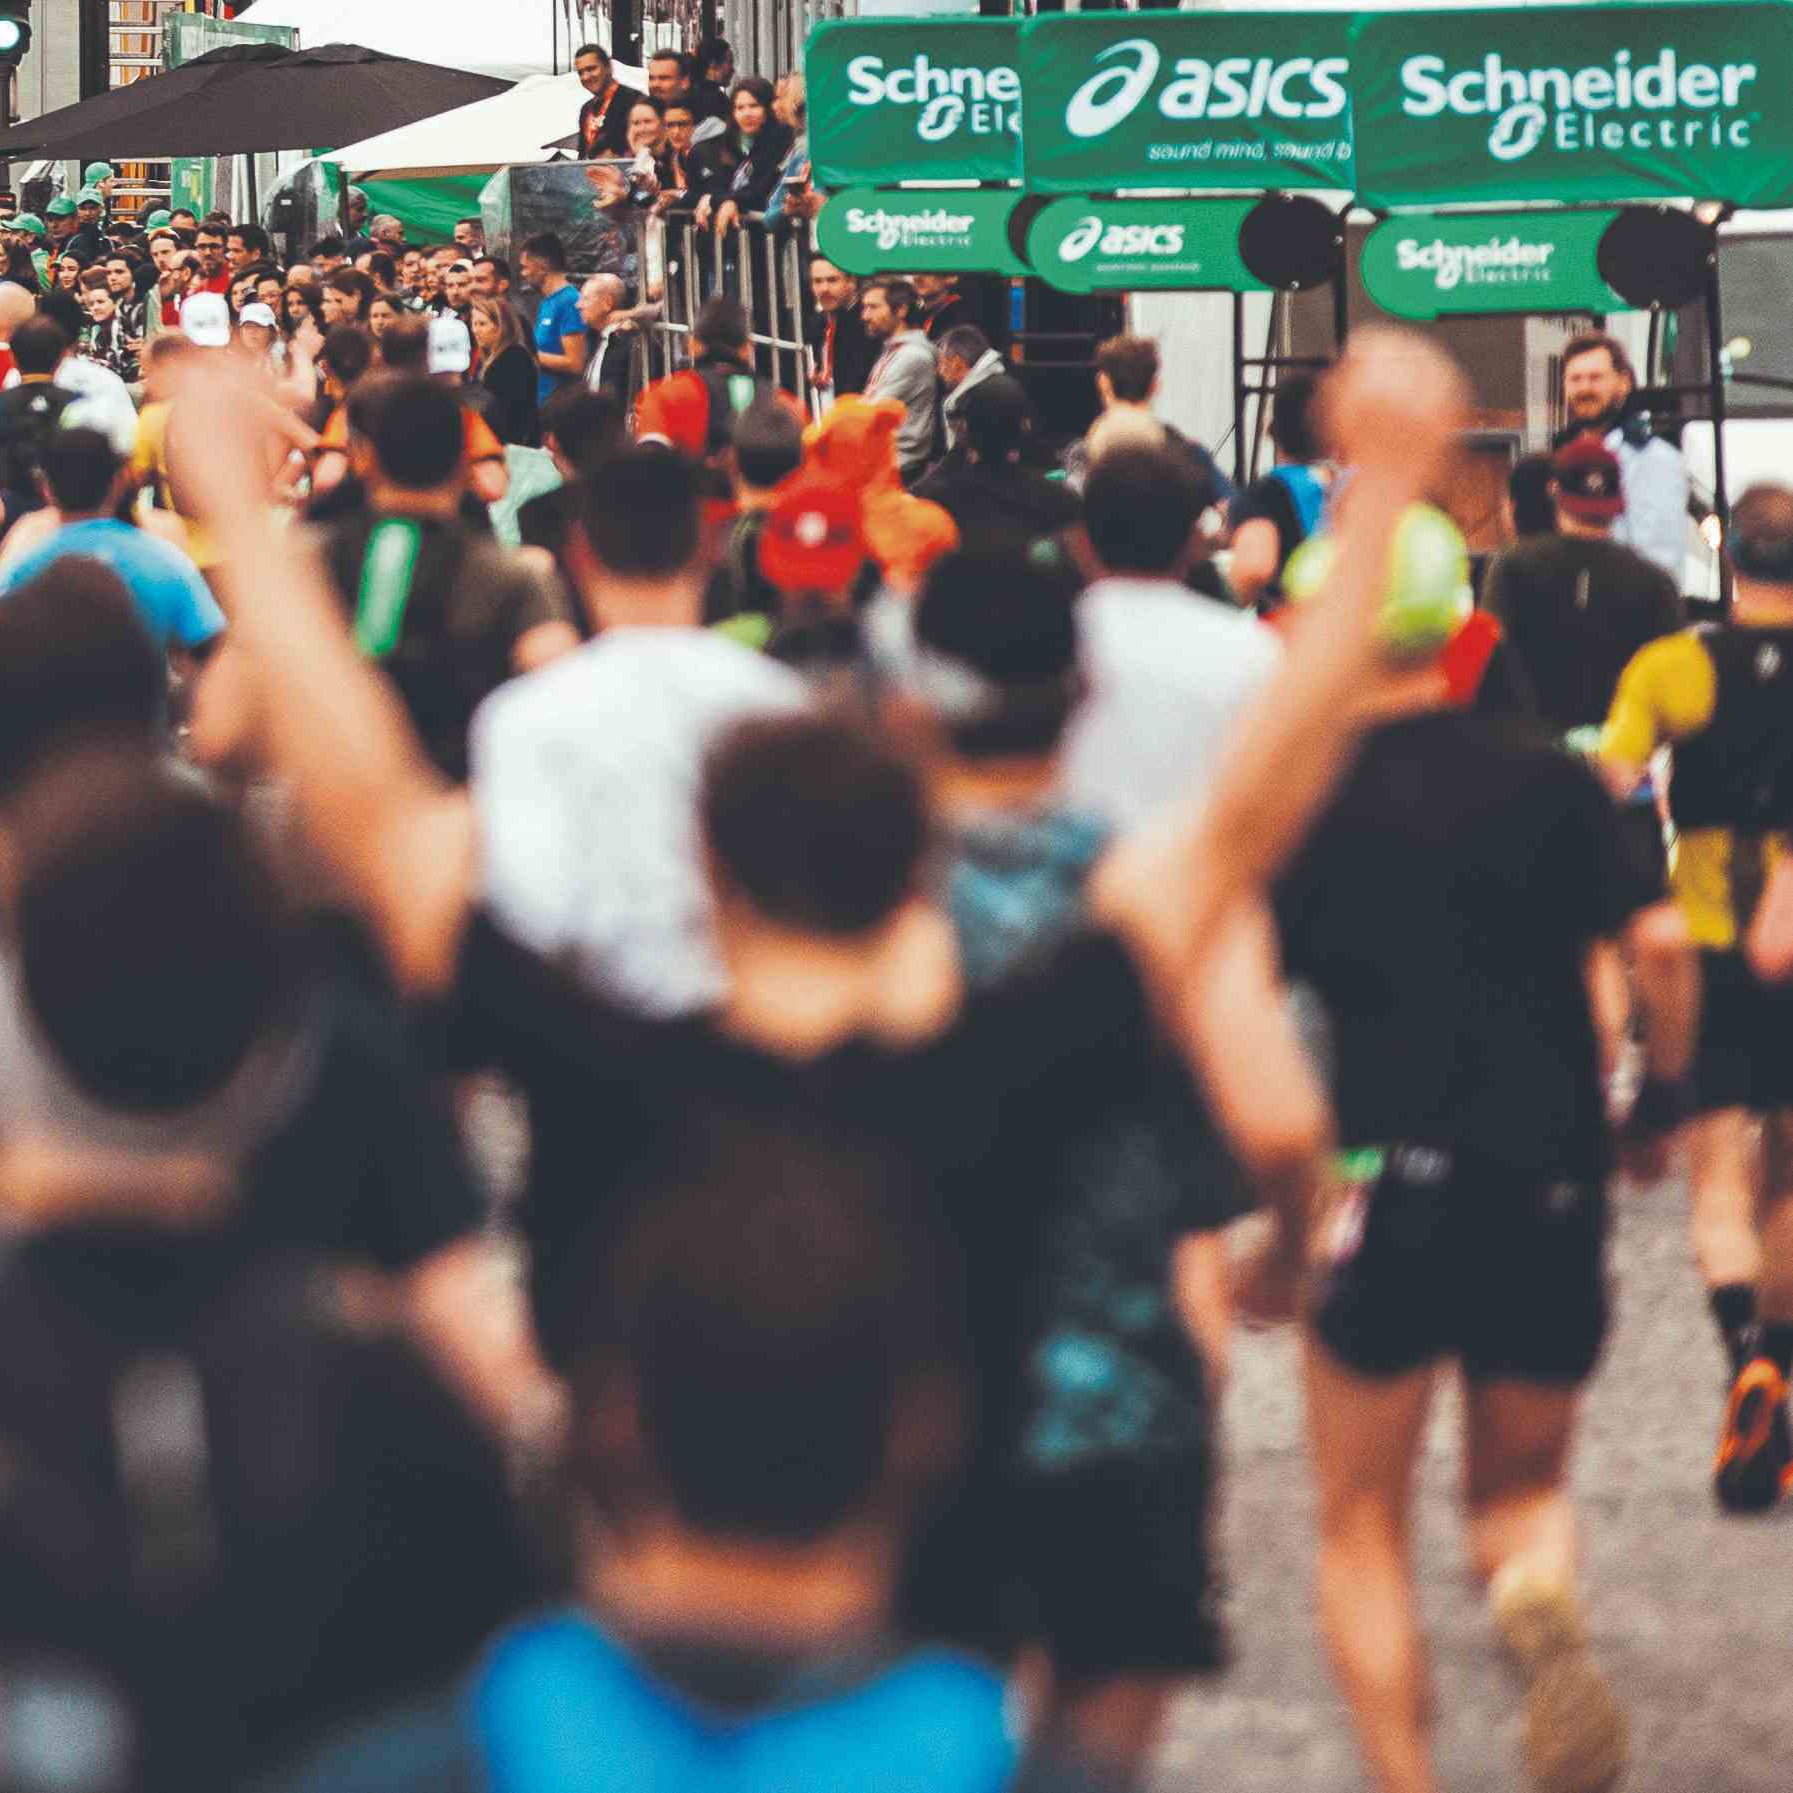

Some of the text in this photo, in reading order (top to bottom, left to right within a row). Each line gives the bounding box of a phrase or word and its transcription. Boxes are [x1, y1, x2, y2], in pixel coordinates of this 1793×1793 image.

[847, 54, 1022, 105] Schne
[1401, 48, 1757, 116] Schneider
[1555, 114, 1751, 150] Electric
[1149, 140, 1212, 161] sound
[1216, 141, 1267, 161] mind,
[846, 208, 975, 234] Schneider
[1396, 235, 1554, 269] Schneider
[1465, 267, 1552, 284] Electric
